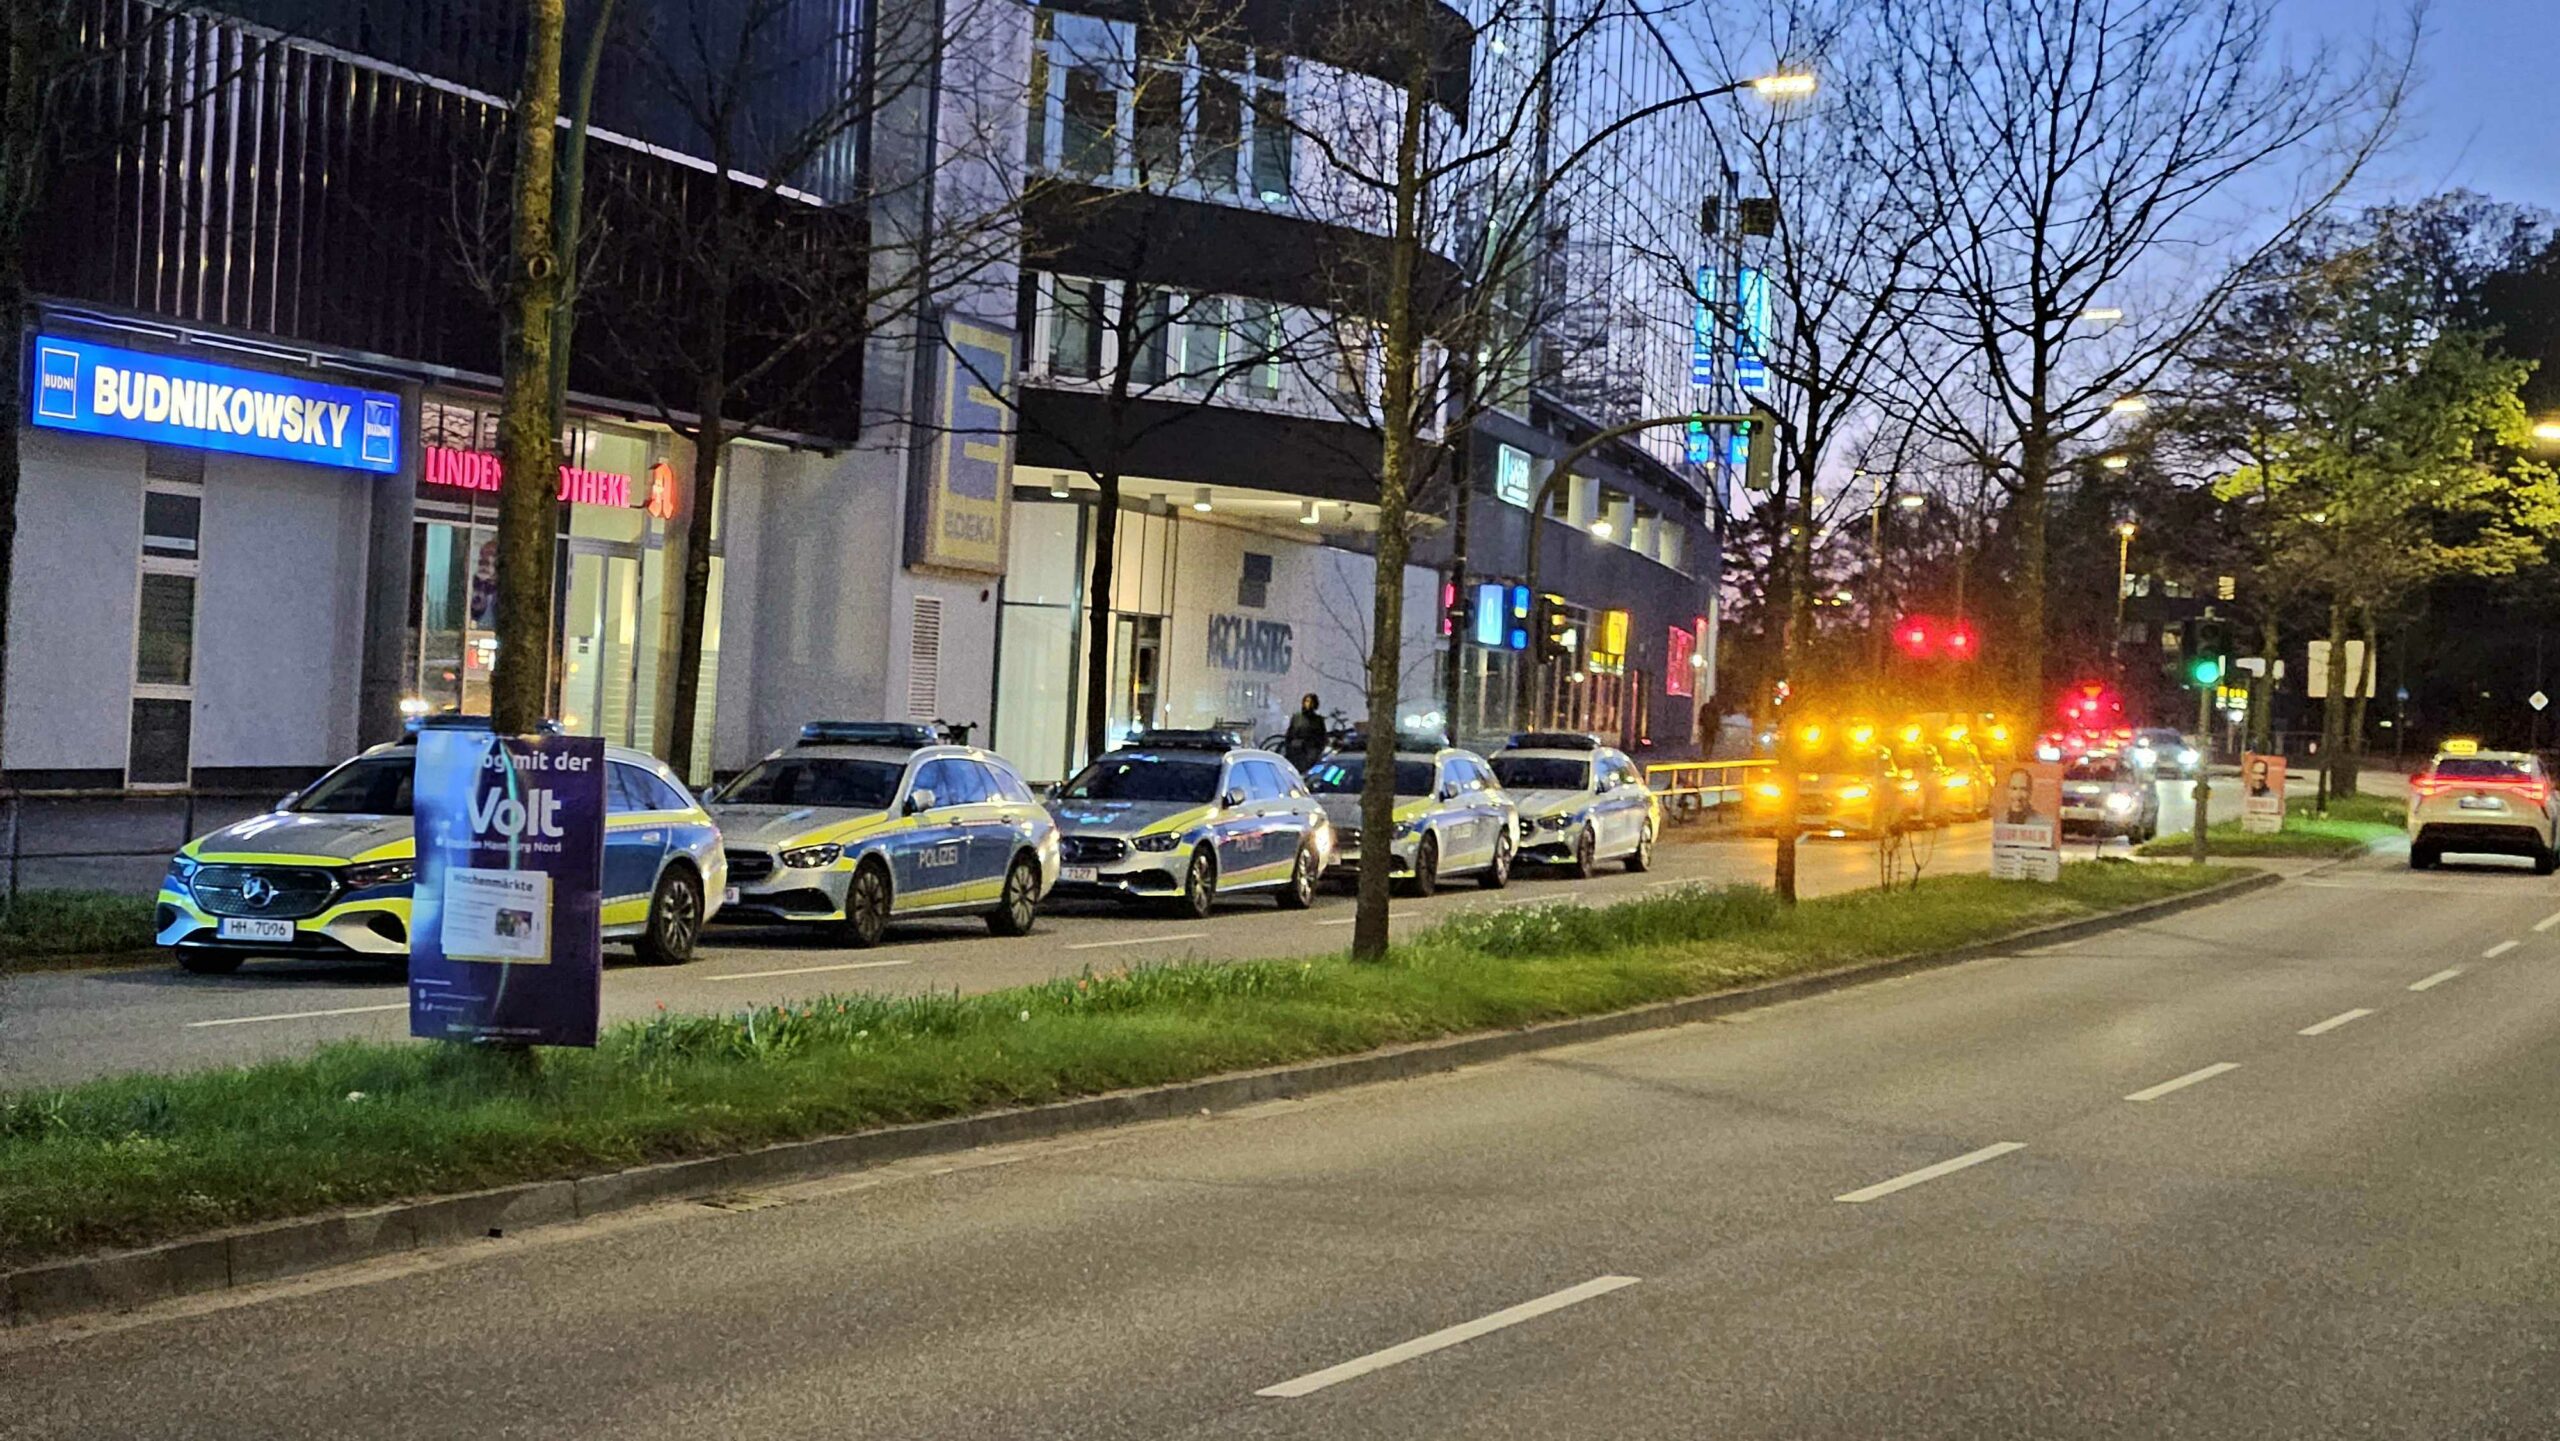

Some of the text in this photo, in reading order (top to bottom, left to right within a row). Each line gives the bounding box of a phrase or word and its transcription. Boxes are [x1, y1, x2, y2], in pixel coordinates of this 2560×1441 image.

[44, 373, 74, 392] BUDNI
[93, 364, 351, 449] BUDNIKOWSKY
[556, 466, 632, 508] OTHEKE
[513, 751, 549, 771] mit
[554, 752, 592, 772] der
[466, 786, 565, 838] Volt
[483, 839, 531, 854] Hamurg
[533, 841, 562, 853] Nord
[918, 845, 958, 869] POLIZEI
[230, 920, 287, 936] HH 7096
